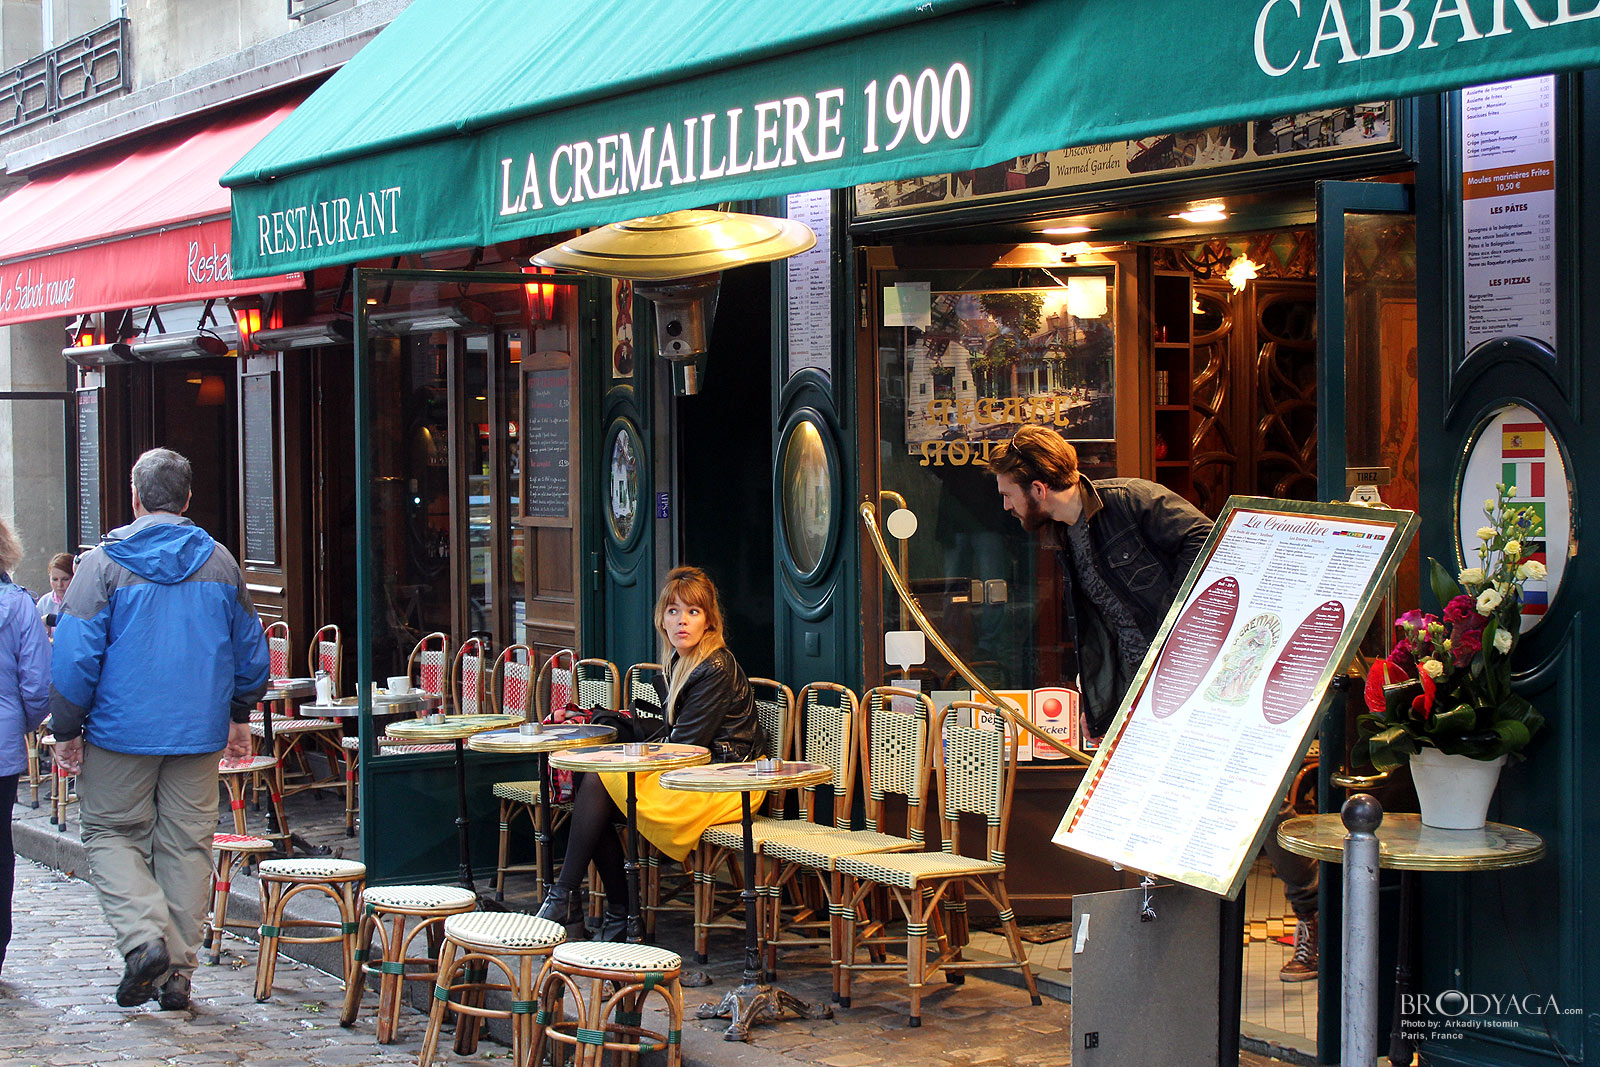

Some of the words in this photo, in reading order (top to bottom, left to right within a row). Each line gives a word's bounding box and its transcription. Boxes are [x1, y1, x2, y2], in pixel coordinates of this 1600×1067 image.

[1253, 0, 1600, 77] CABA
[499, 152, 545, 217] LA
[549, 87, 847, 207] CREMAILLERE
[862, 62, 972, 155] 1900
[1064, 144, 1096, 158] Discover
[1098, 143, 1113, 152] our
[1056, 158, 1090, 176] Warmed
[1091, 155, 1120, 175] Garden
[1468, 176, 1492, 185] Moules
[1493, 171, 1529, 182] marinières
[1531, 168, 1550, 177] Frites
[1496, 182, 1514, 192] 10,50
[1490, 206, 1503, 215] LES
[1505, 203, 1528, 213] PÂTES
[258, 186, 402, 257] RESTAURANT
[14, 268, 44, 311] Sabot
[45, 277, 75, 309] rouge
[1489, 279, 1502, 287] LES
[1504, 276, 1531, 285] PIZZAS
[1357, 472, 1377, 481] TIREZ
[1243, 515, 1262, 528] La
[1264, 516, 1329, 536] Crémaillère
